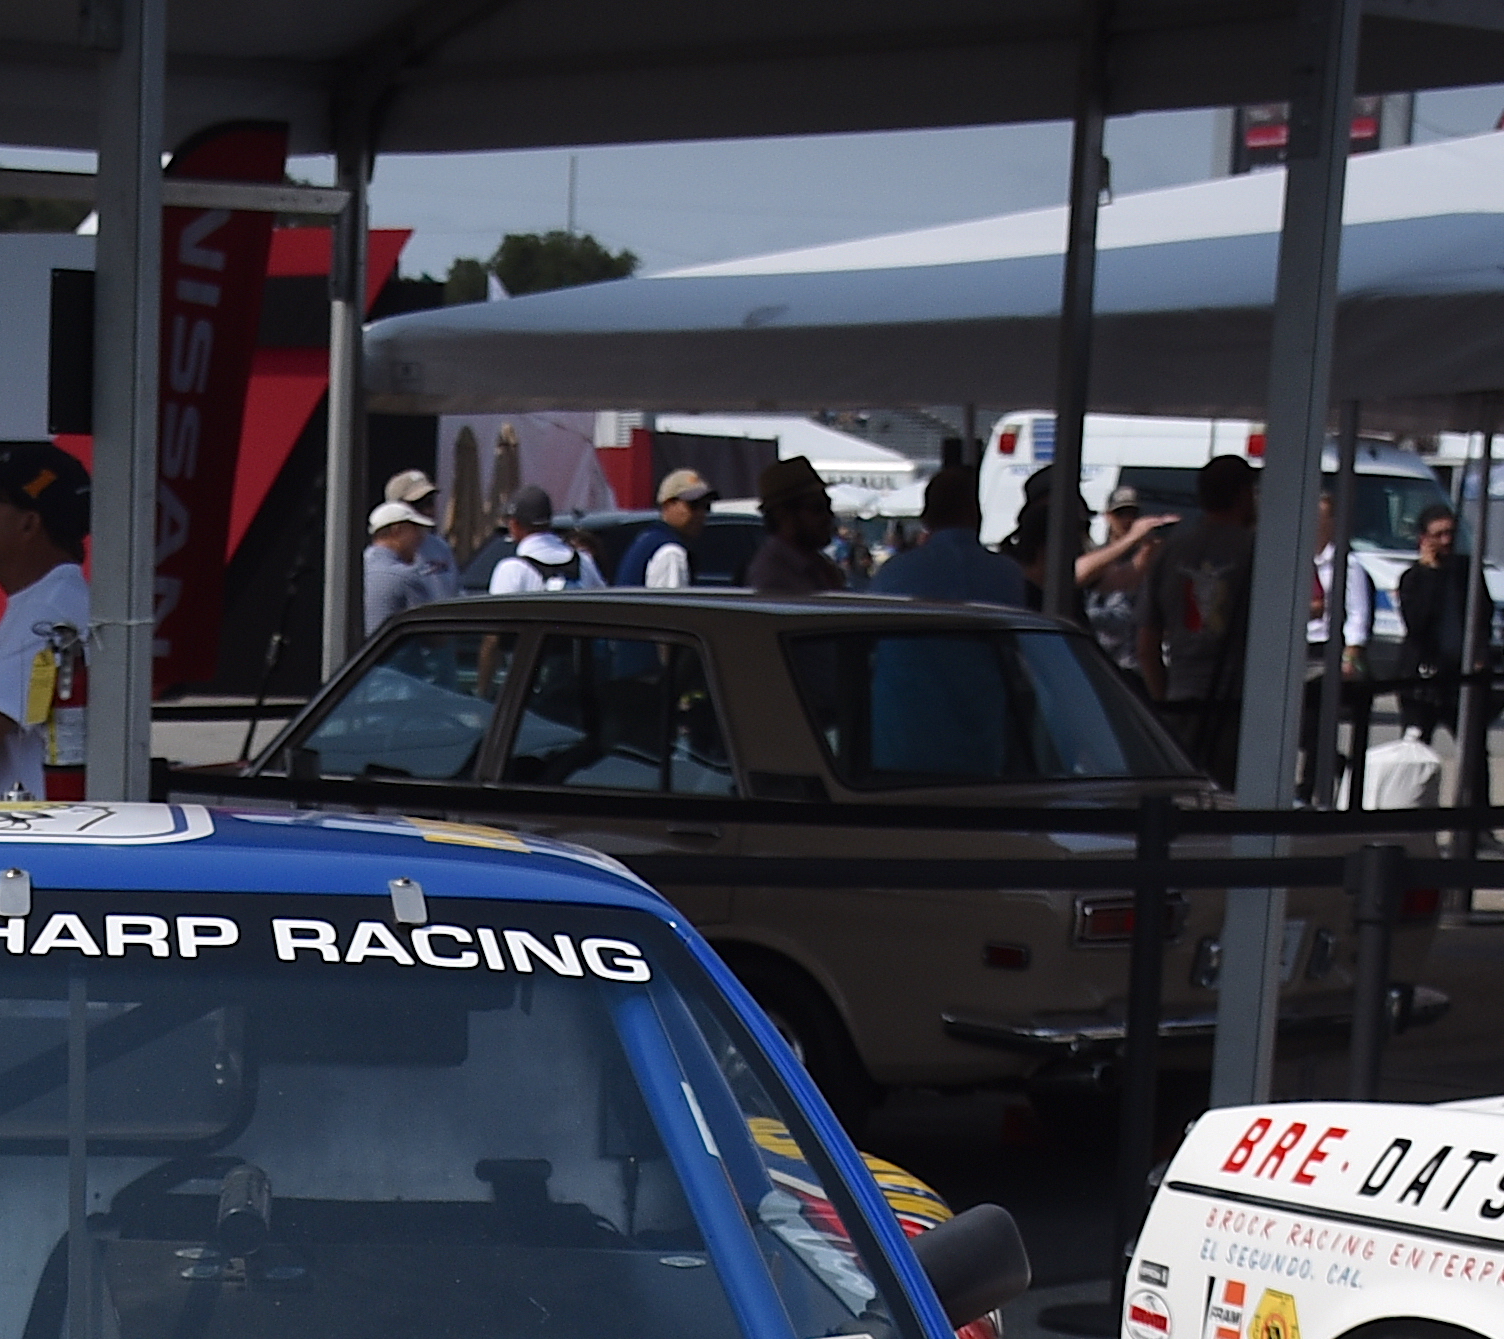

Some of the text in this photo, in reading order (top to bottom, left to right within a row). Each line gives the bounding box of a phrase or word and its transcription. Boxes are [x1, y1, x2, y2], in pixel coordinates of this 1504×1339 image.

[152, 207, 233, 658] NISSAN
[271, 917, 652, 984] RACING
[1220, 1117, 1350, 1187] BRE
[1199, 1237, 1221, 1262] EL
[1205, 1207, 1276, 1239] BROCK
[1285, 1222, 1377, 1262] RACING
[1210, 1305, 1241, 1325] FRAM
